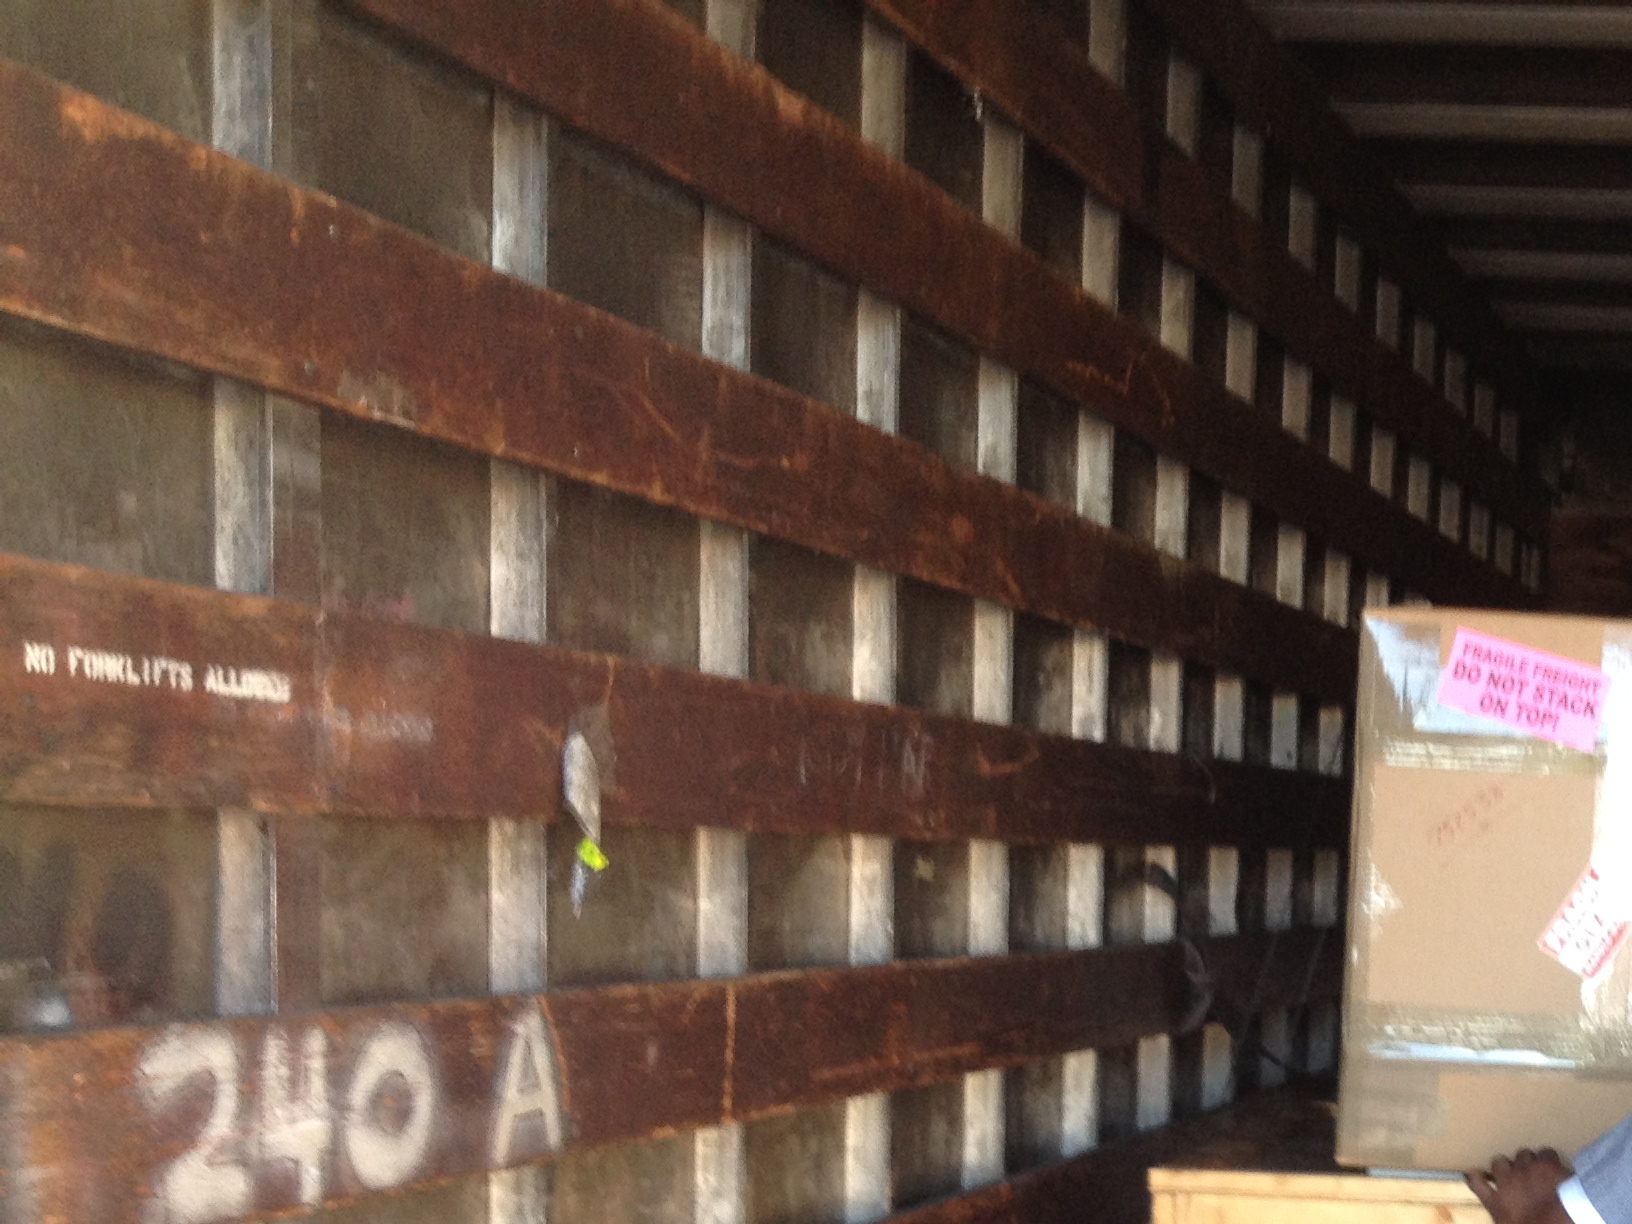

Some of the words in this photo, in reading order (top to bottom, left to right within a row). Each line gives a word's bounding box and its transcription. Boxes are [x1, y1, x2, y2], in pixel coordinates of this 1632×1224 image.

[23, 640, 56, 676] NO
[1464, 641, 1528, 673] FRAGILE
[1534, 662, 1602, 696] FREIGHT
[1453, 658, 1482, 686] DO
[1486, 668, 1529, 699] NOT
[1533, 684, 1596, 719] STACK
[1479, 691, 1510, 719] ON
[490, 1000, 564, 1163] A
